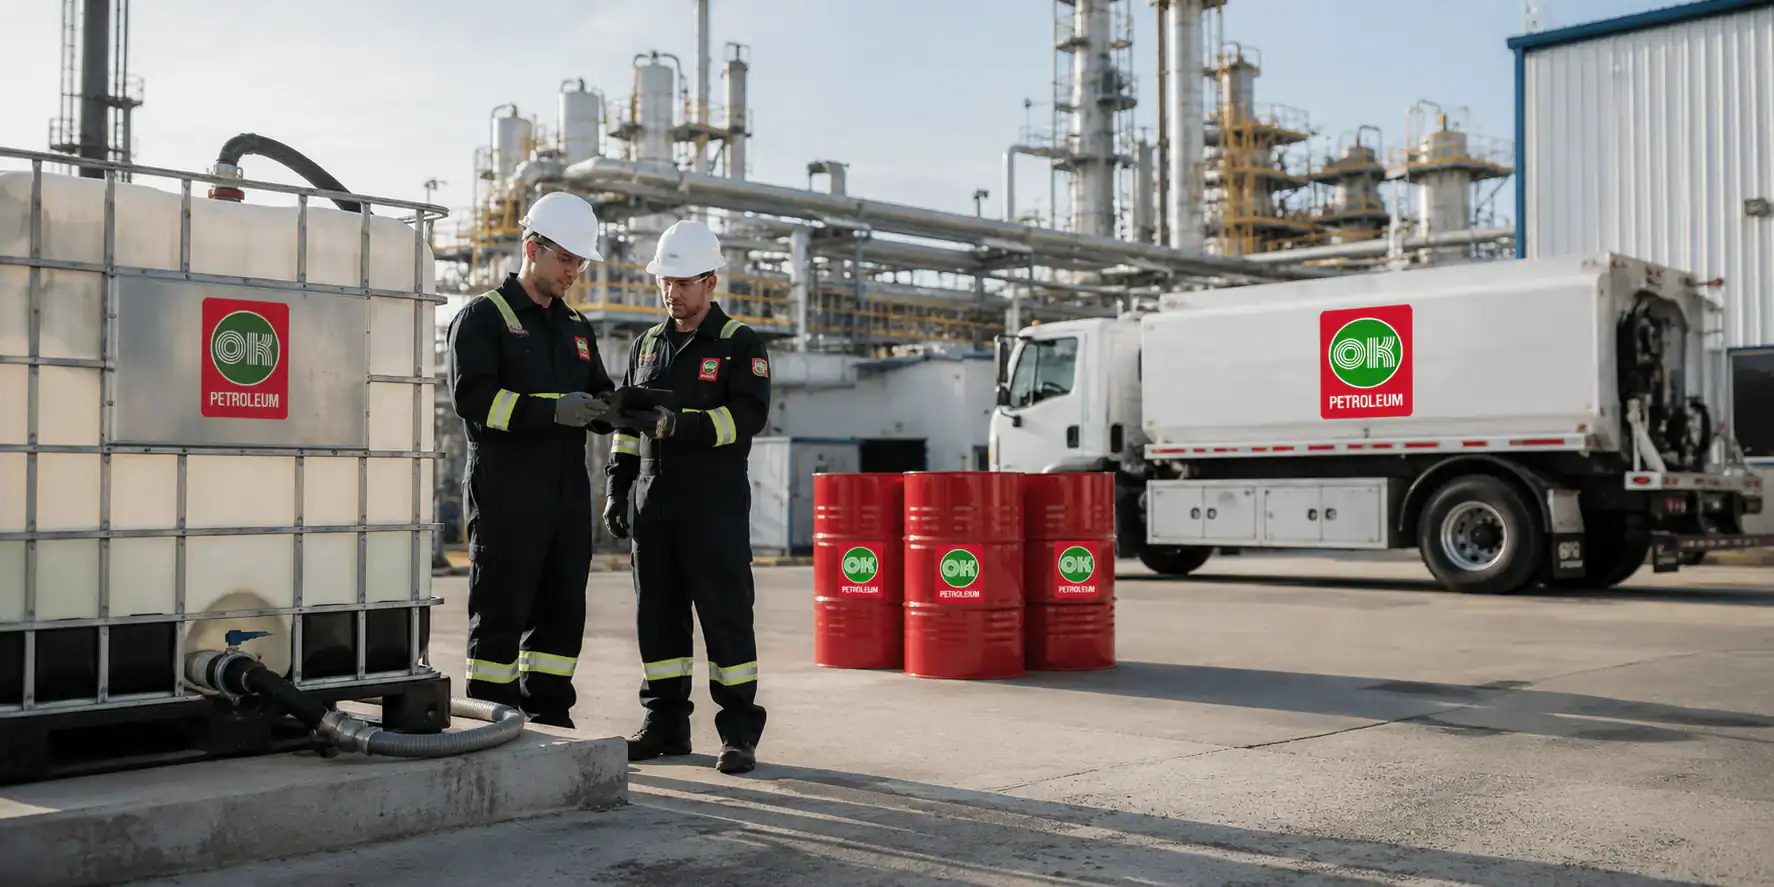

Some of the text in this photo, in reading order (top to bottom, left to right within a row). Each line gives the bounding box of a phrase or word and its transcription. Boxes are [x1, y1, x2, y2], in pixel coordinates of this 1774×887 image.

[214, 330, 273, 366] OK
[1333, 336, 1395, 370] OK
[210, 391, 279, 408] PETROLEUM
[1329, 393, 1404, 410] PETROLEUM
[844, 556, 875, 574] OK
[942, 559, 976, 577] OK
[1060, 555, 1091, 573] OK
